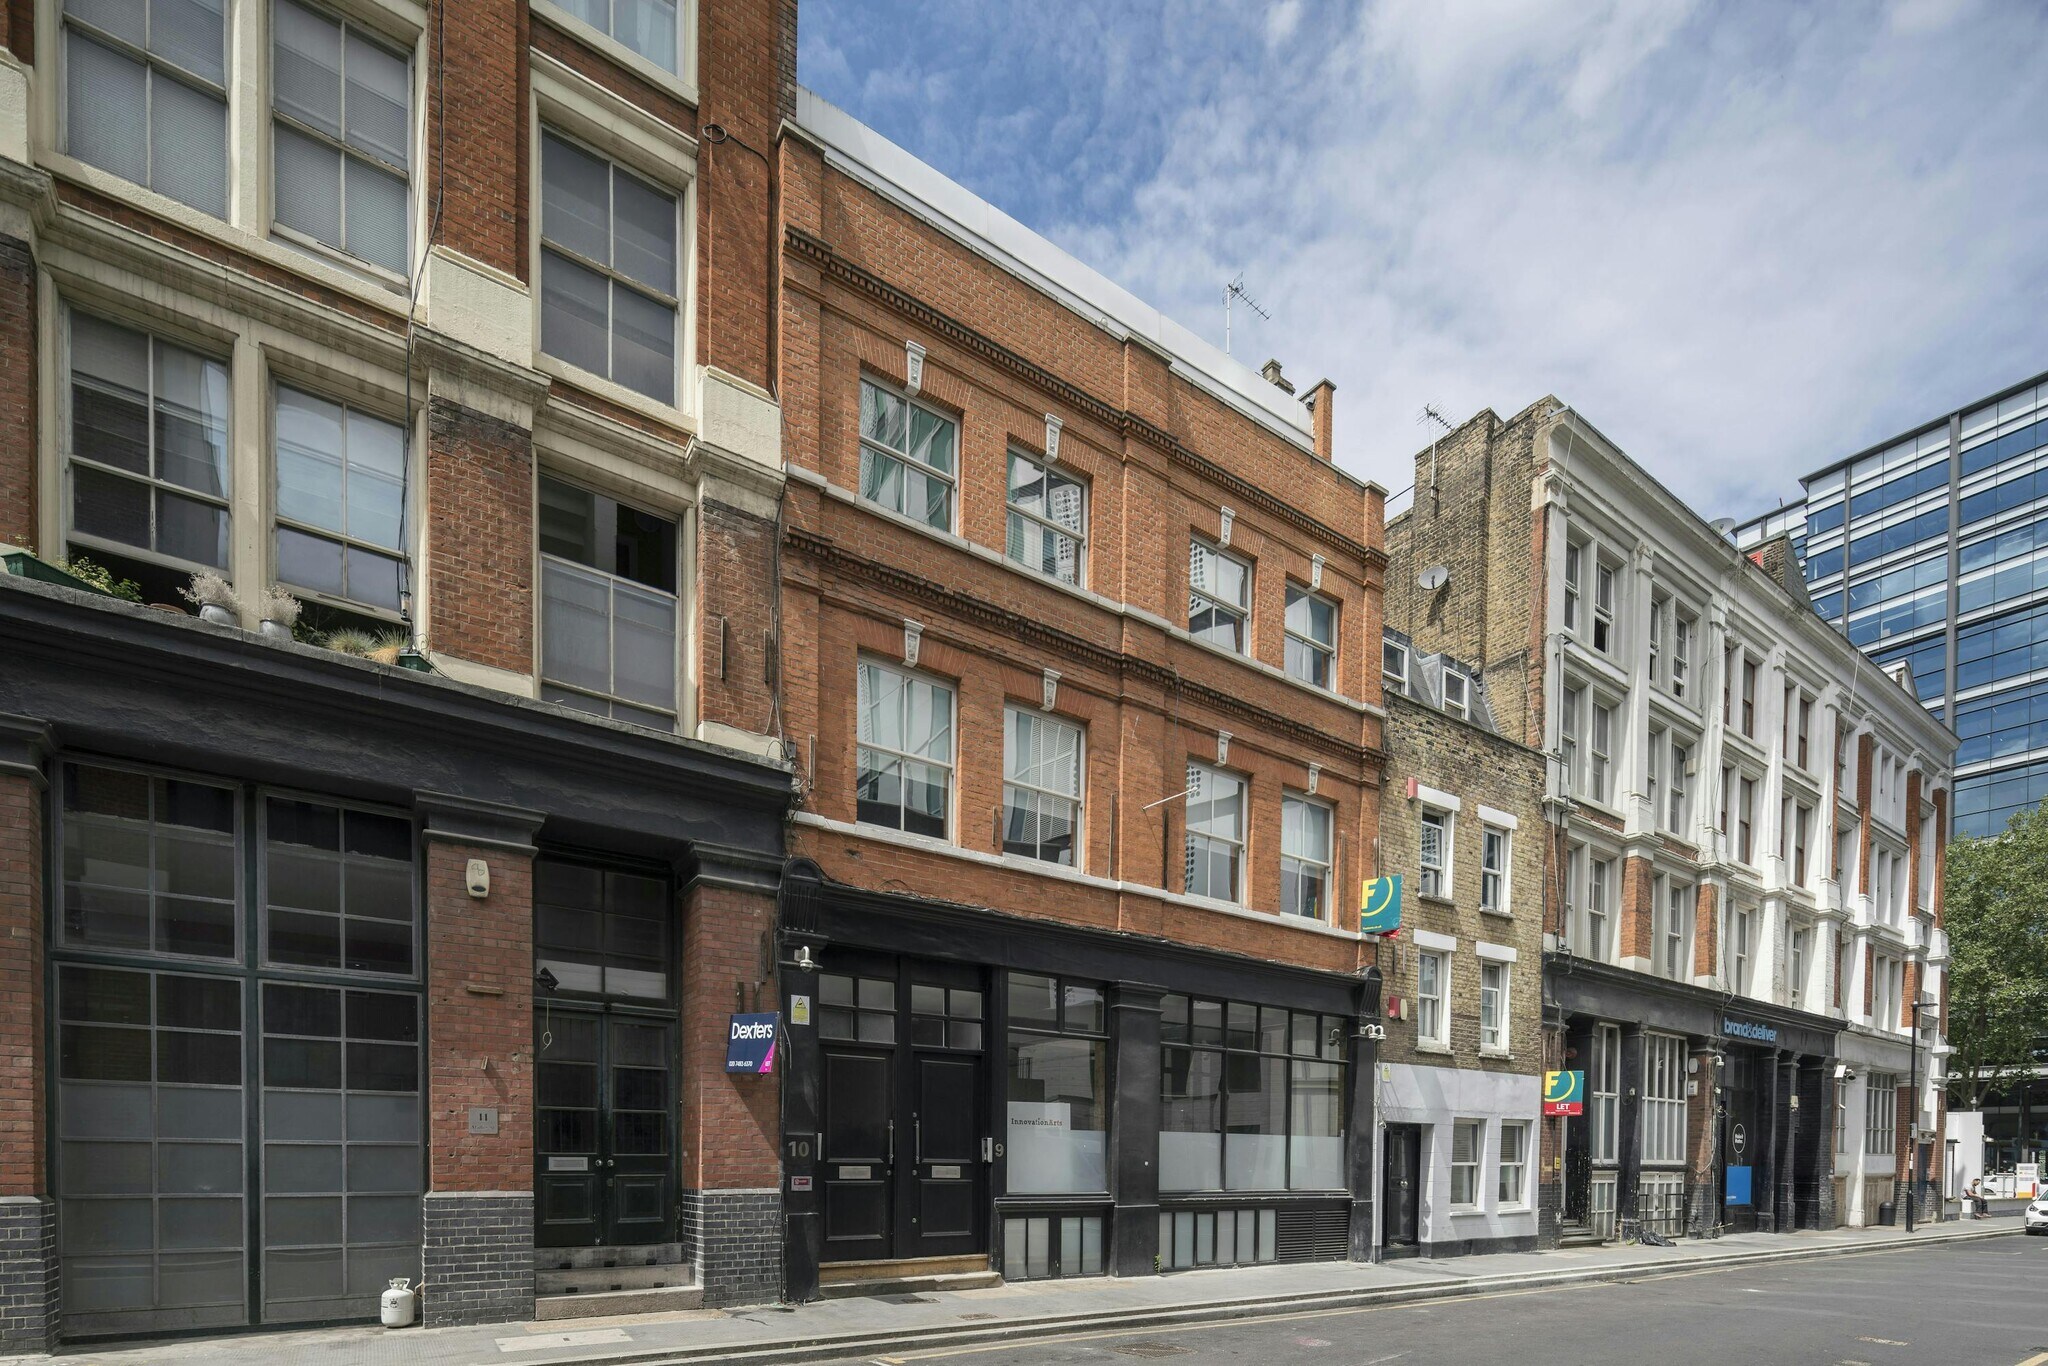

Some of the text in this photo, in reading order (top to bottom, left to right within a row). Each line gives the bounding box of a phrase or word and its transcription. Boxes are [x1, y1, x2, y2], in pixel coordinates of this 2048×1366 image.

[732, 1022, 772, 1039] Dexters
[1725, 1017, 1776, 1042] brand&deliver
[480, 1113, 487, 1121] 11
[788, 1141, 809, 1157] 10
[995, 1143, 1004, 1157] 9
